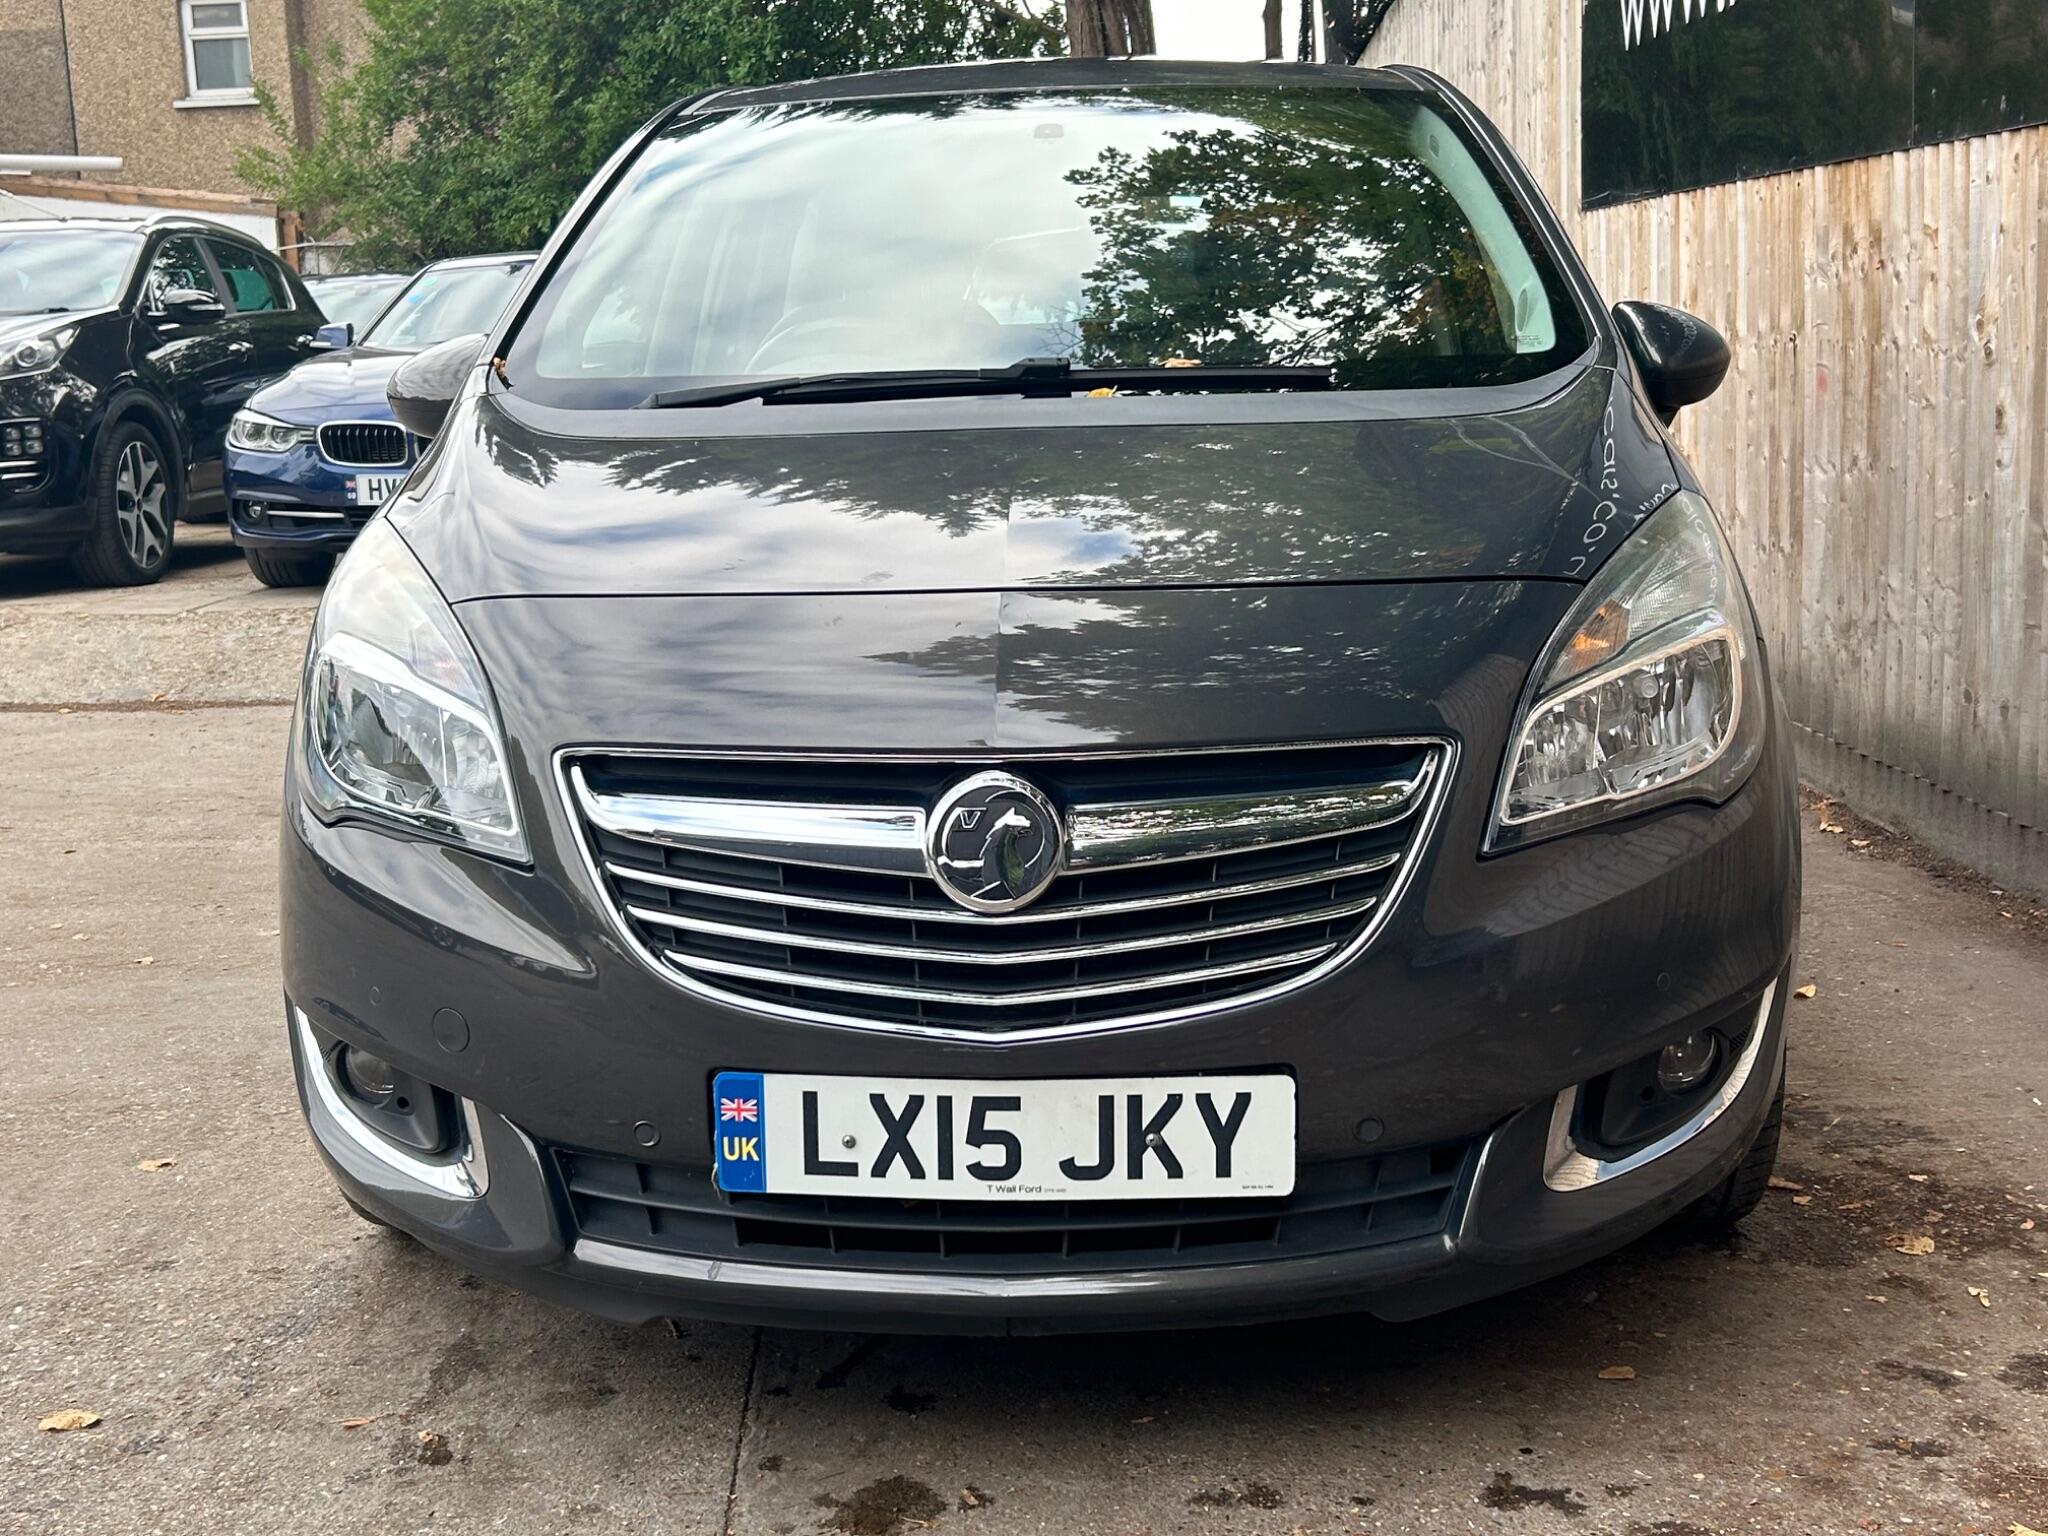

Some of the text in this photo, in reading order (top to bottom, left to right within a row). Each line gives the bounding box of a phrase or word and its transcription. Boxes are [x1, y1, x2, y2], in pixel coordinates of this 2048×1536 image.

[368, 478, 401, 500] HV
[802, 1091, 1252, 1181] LX15 JKY
[723, 1137, 759, 1162] UK
[987, 1184, 993, 1193] T
[995, 1184, 1017, 1193] Wall
[1019, 1184, 1042, 1193] Ford
